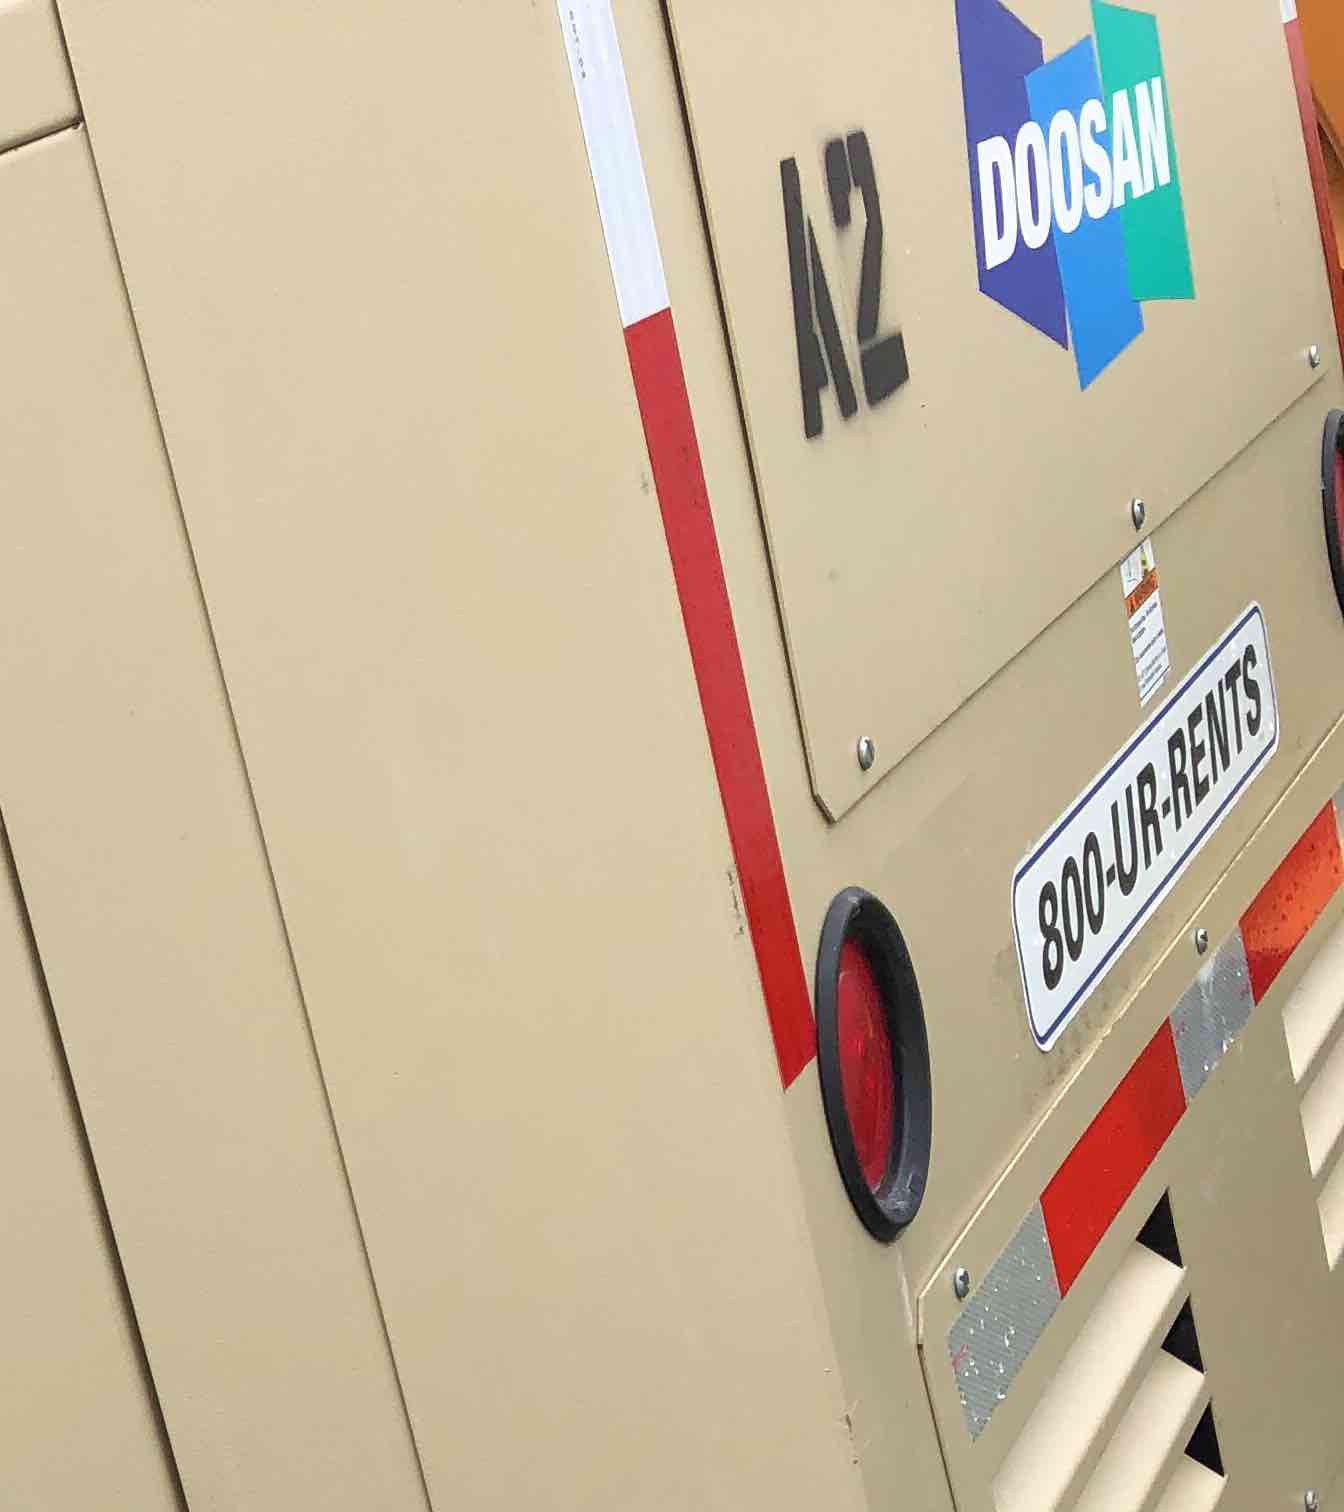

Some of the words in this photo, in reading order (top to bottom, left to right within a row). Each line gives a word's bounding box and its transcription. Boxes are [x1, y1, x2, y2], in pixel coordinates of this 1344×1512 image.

[779, 129, 910, 441] A2
[976, 76, 1171, 271] DOOSAN
[1037, 642, 1263, 992] 800-UR-RENTS
